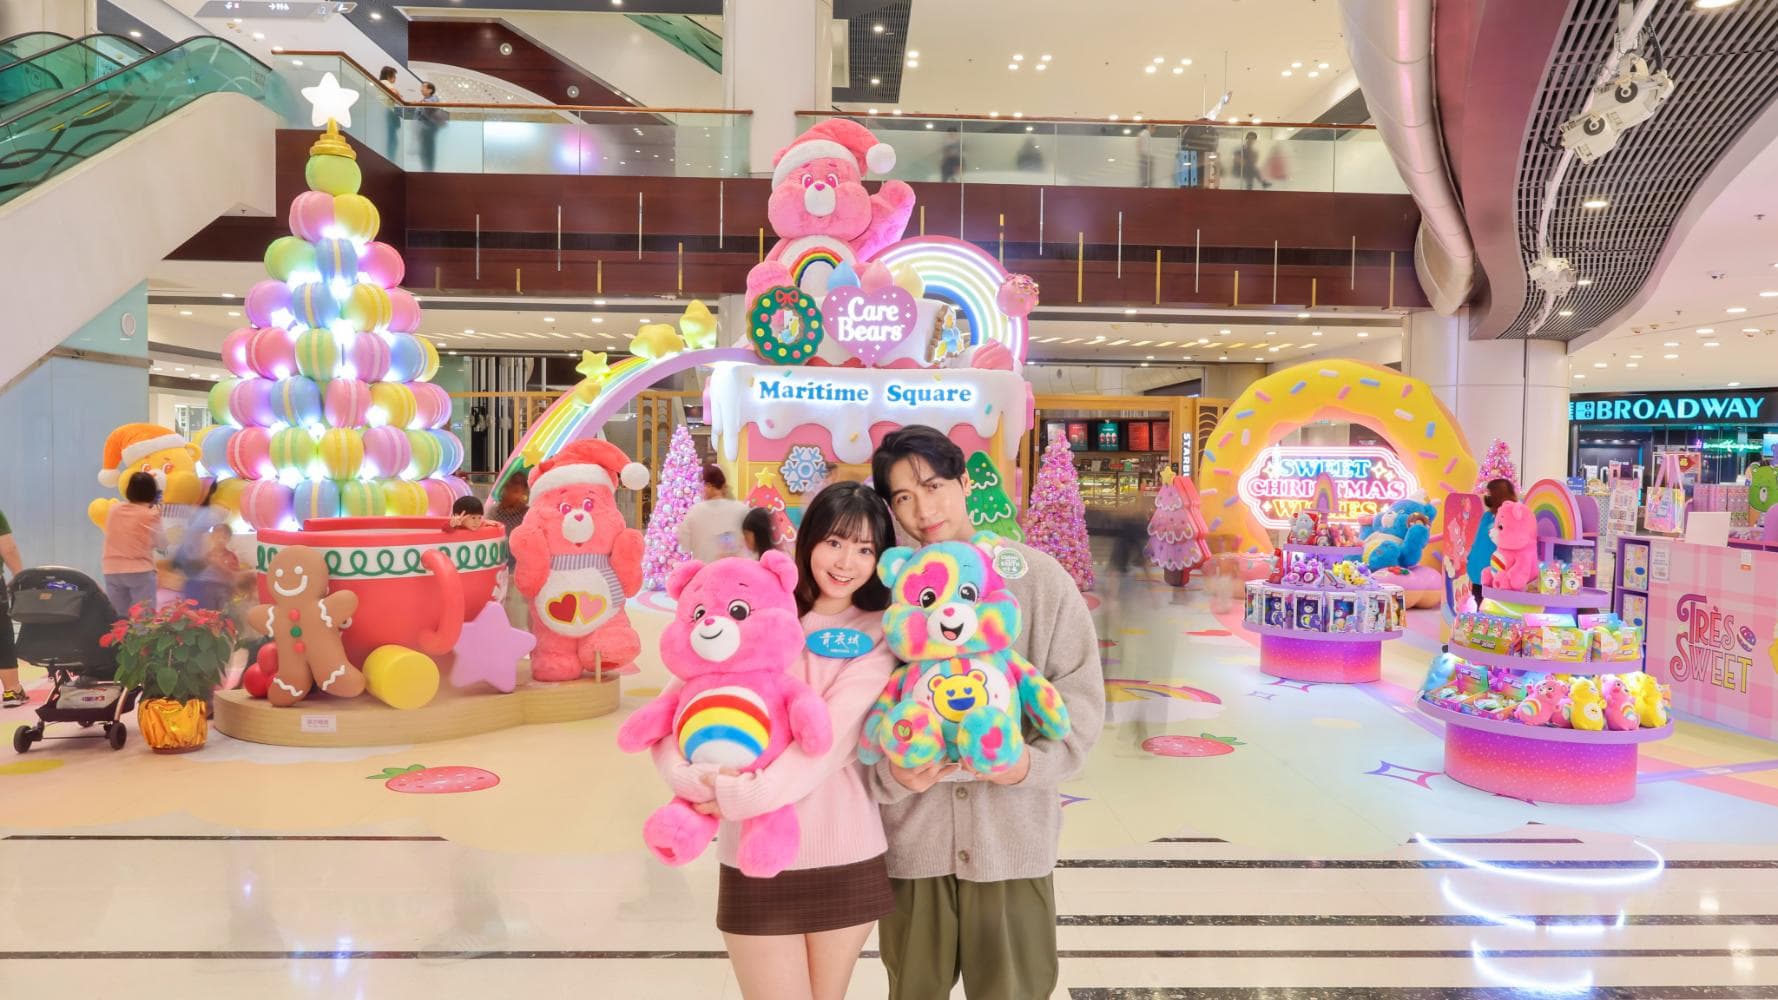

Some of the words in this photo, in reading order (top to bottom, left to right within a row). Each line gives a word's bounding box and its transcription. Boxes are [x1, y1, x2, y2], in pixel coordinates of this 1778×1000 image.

[847, 296, 899, 322] Care
[837, 316, 902, 342] Bears
[759, 381, 869, 401] Maritime
[887, 385, 972, 406] Square
[1597, 397, 1765, 420] BROADWAY
[1280, 458, 1371, 479] SWEET
[1249, 479, 1406, 500] CHRITMAS
[1670, 632, 1753, 694] SWEET
